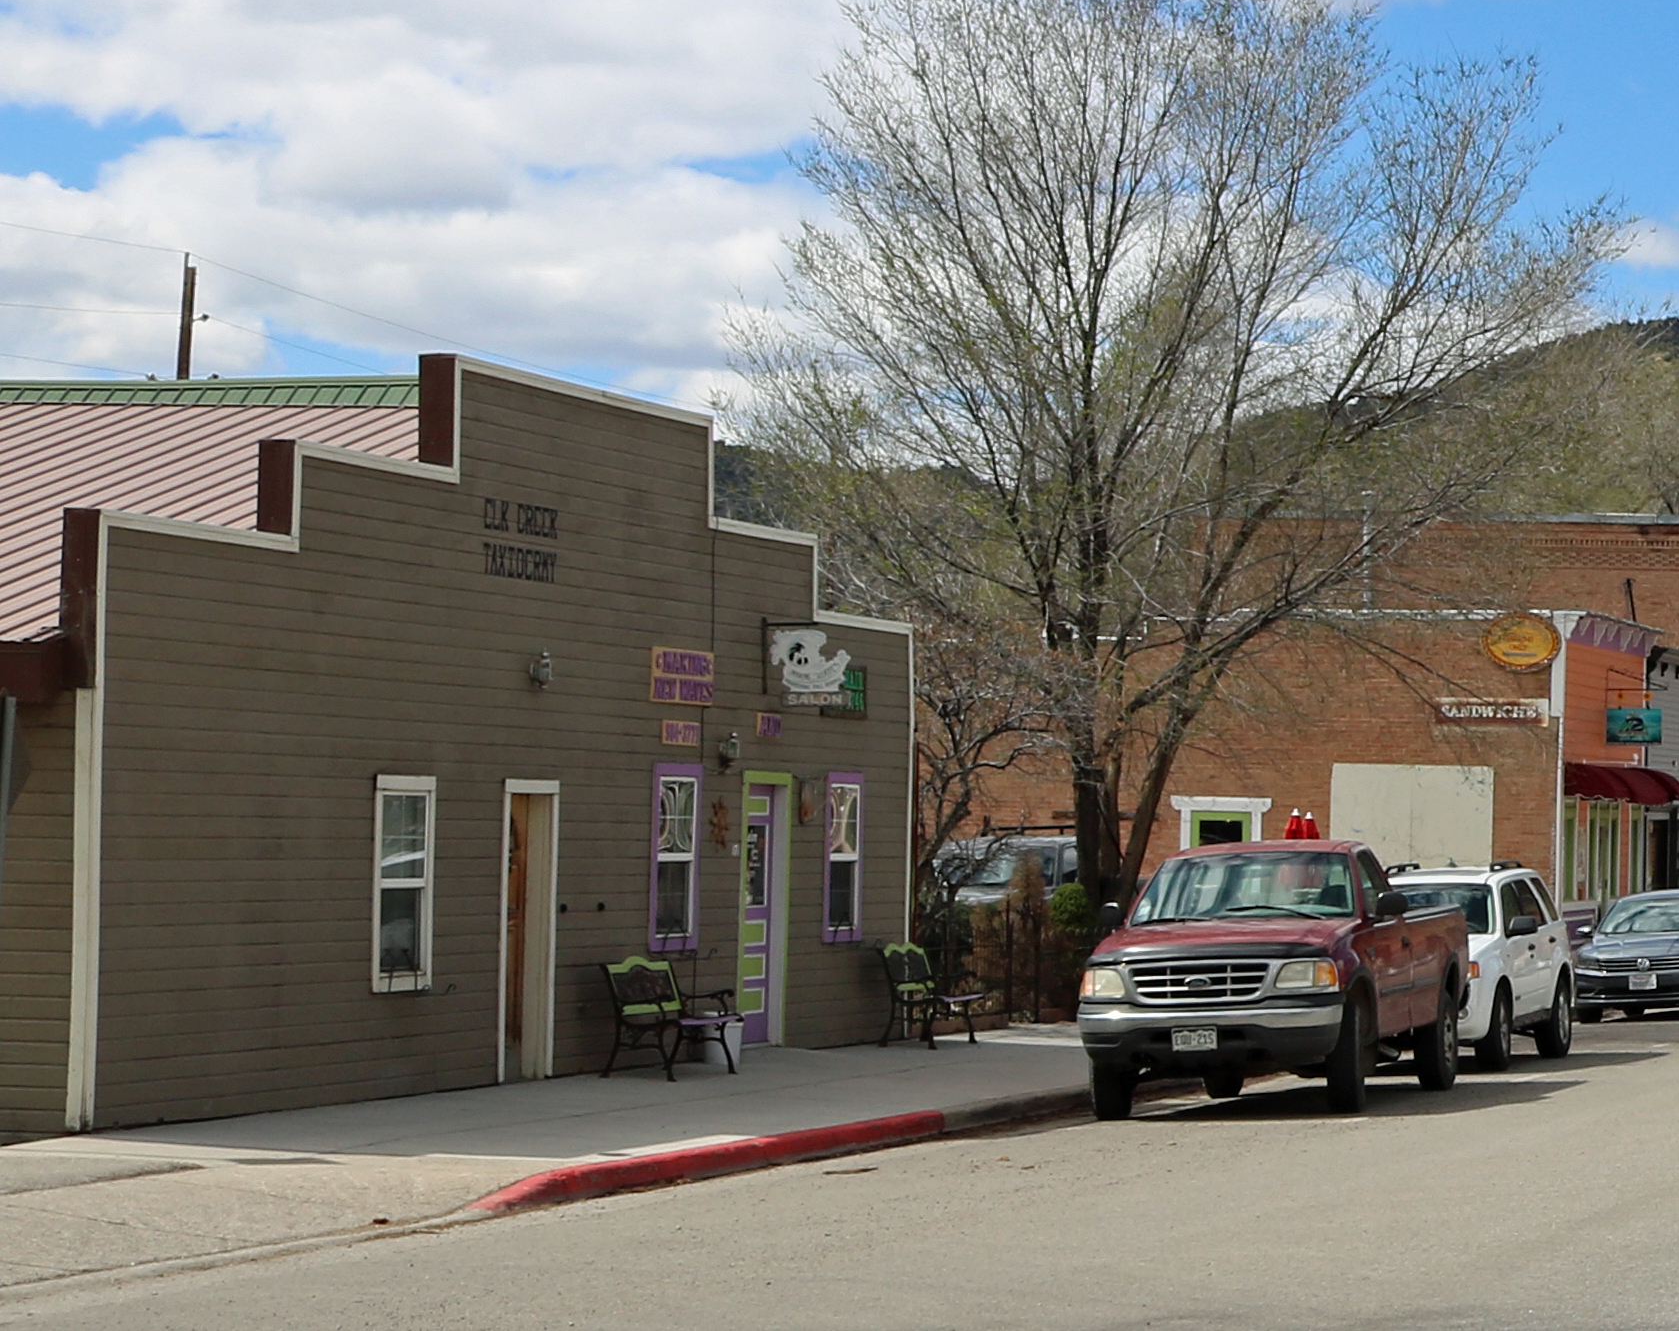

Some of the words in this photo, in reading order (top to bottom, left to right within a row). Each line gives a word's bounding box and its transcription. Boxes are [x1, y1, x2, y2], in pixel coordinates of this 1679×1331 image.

[484, 498, 509, 532] ELK
[517, 503, 558, 540] CREEK
[483, 541, 557, 583] TAXIDERMY
[788, 693, 842, 705] SALON
